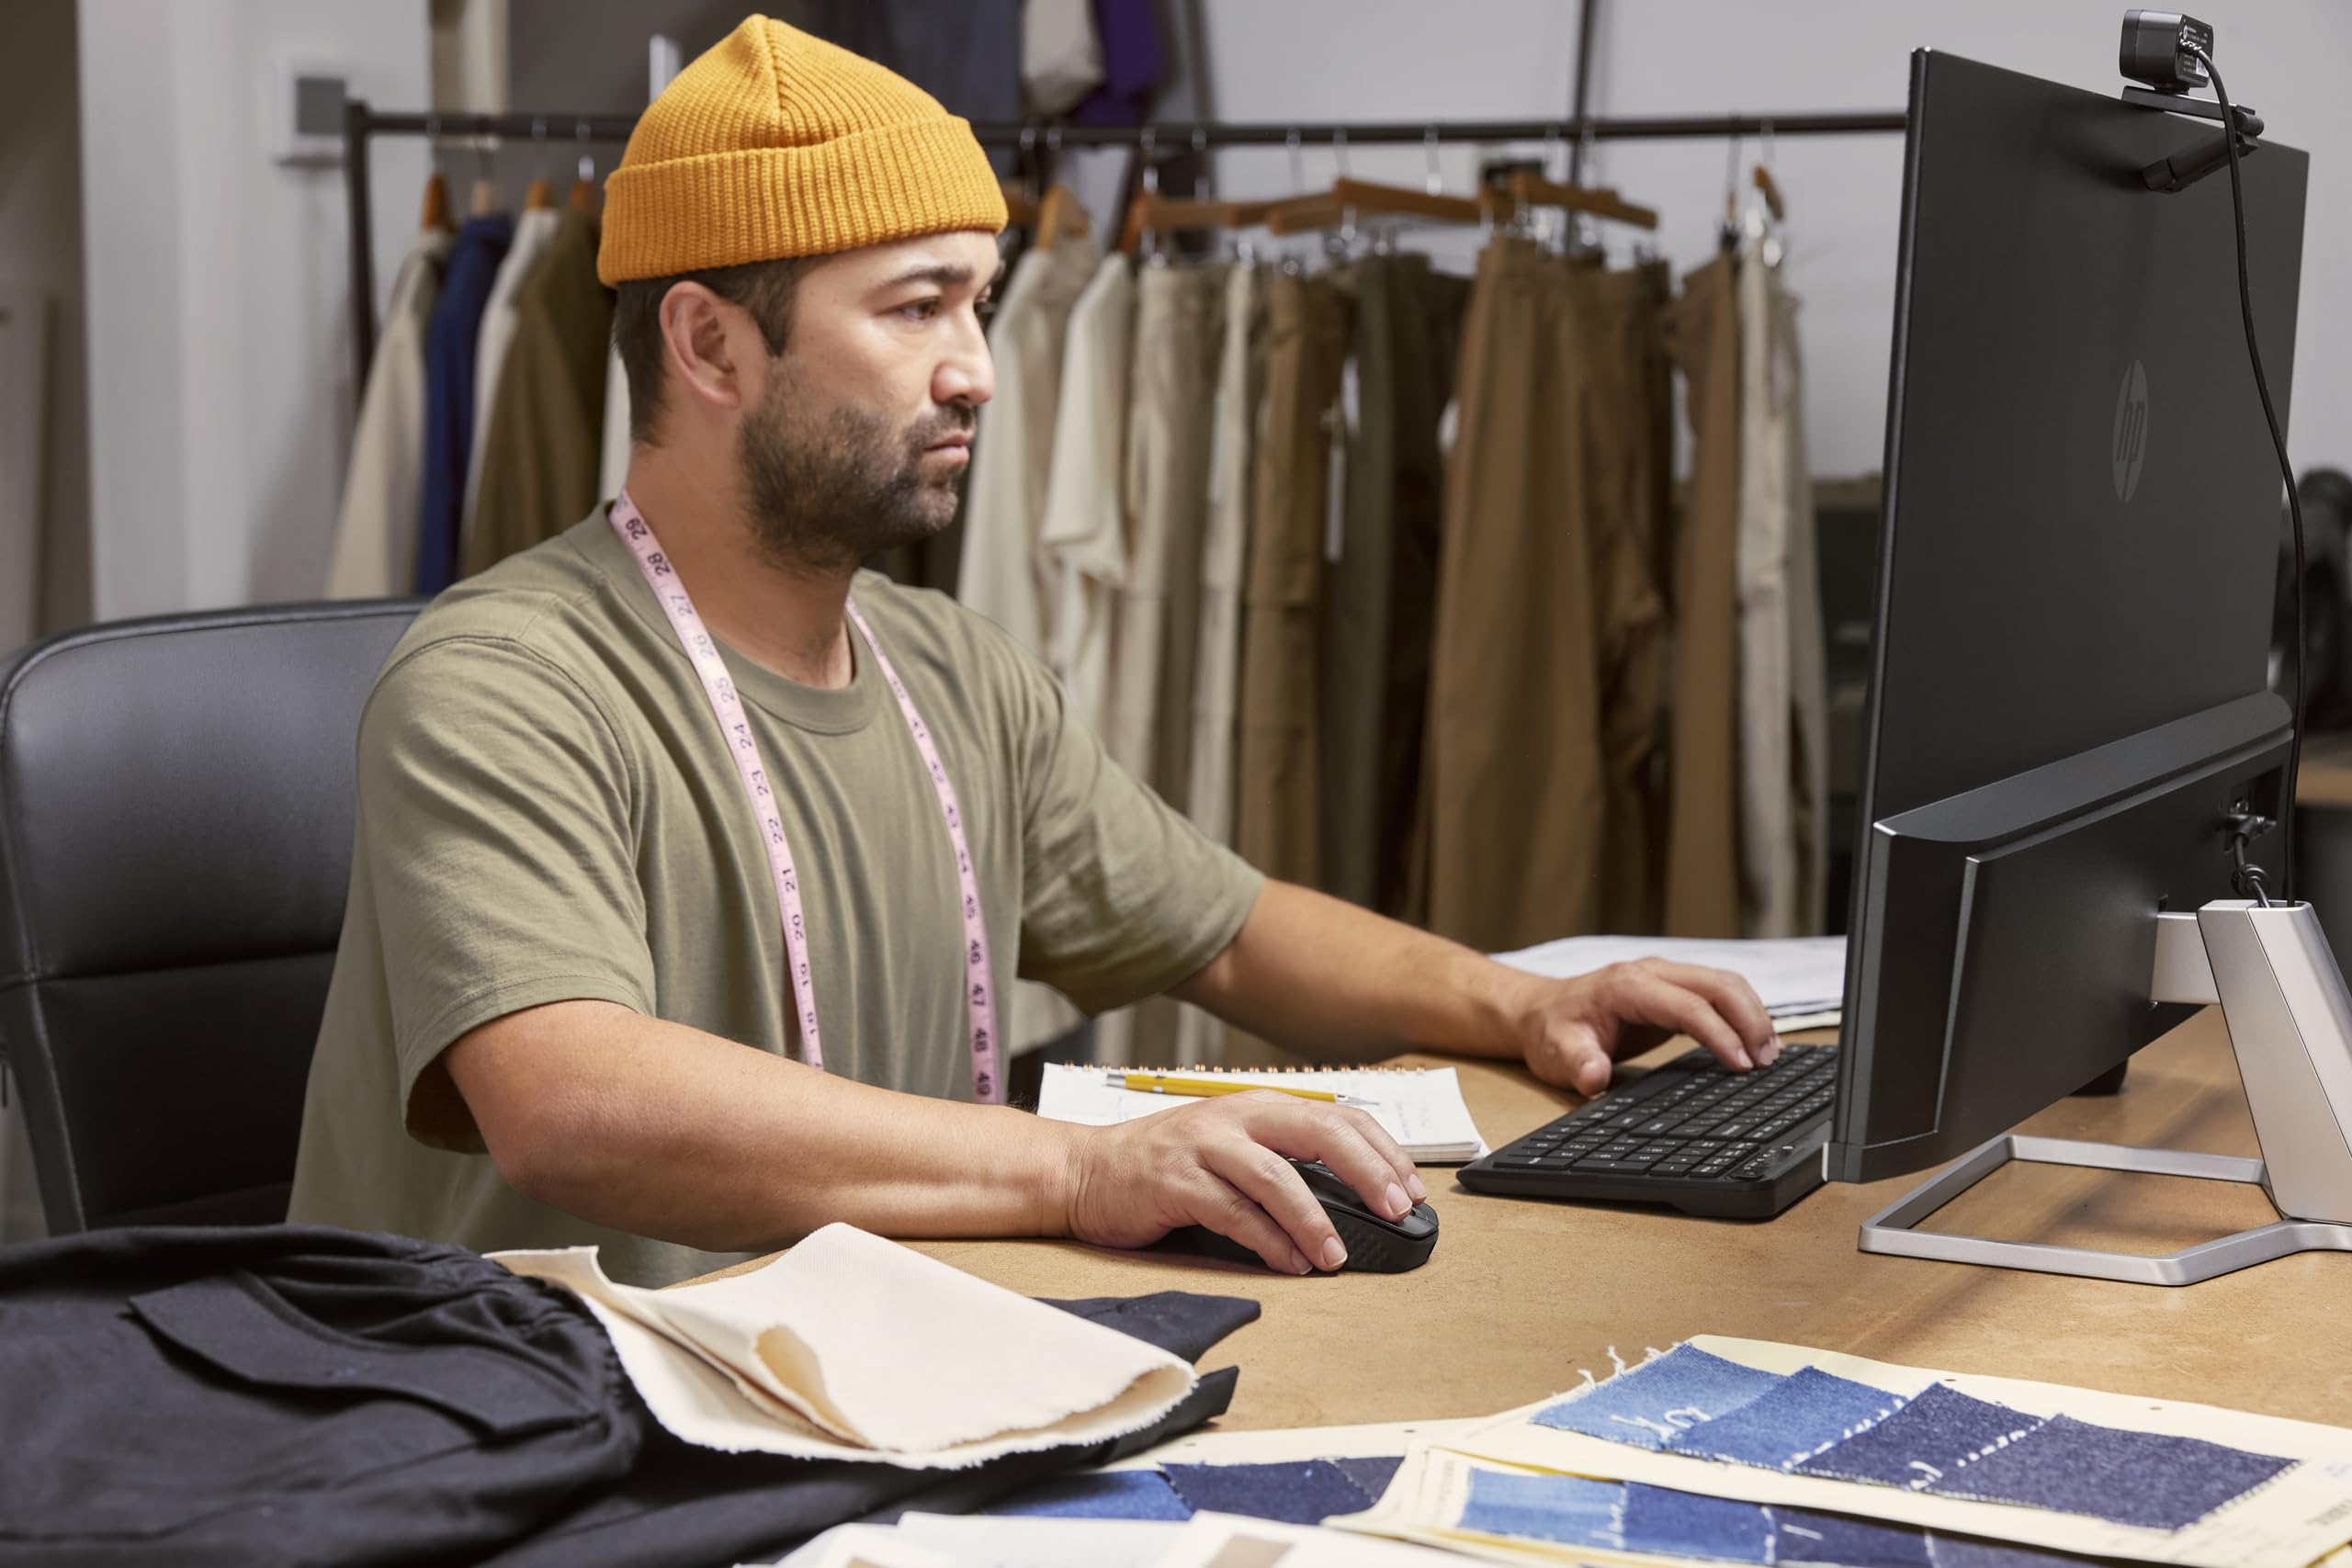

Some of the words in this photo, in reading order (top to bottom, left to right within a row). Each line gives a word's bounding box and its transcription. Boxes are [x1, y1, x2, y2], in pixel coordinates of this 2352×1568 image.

[2116, 359, 2146, 502] hp
[626, 517, 648, 540] 29
[647, 552, 671, 576] 28
[670, 594, 694, 616] 27
[695, 634, 715, 659] 26
[717, 677, 736, 703] 25
[734, 724, 752, 749] 24
[752, 770, 769, 795] 23
[768, 818, 783, 843] 22
[782, 868, 796, 893] 21
[792, 914, 805, 941] 20
[969, 939, 981, 964] 46
[800, 963, 809, 986] 19
[972, 984, 986, 1007] 47
[974, 1028, 989, 1053] 48
[976, 1072, 991, 1096] 49
